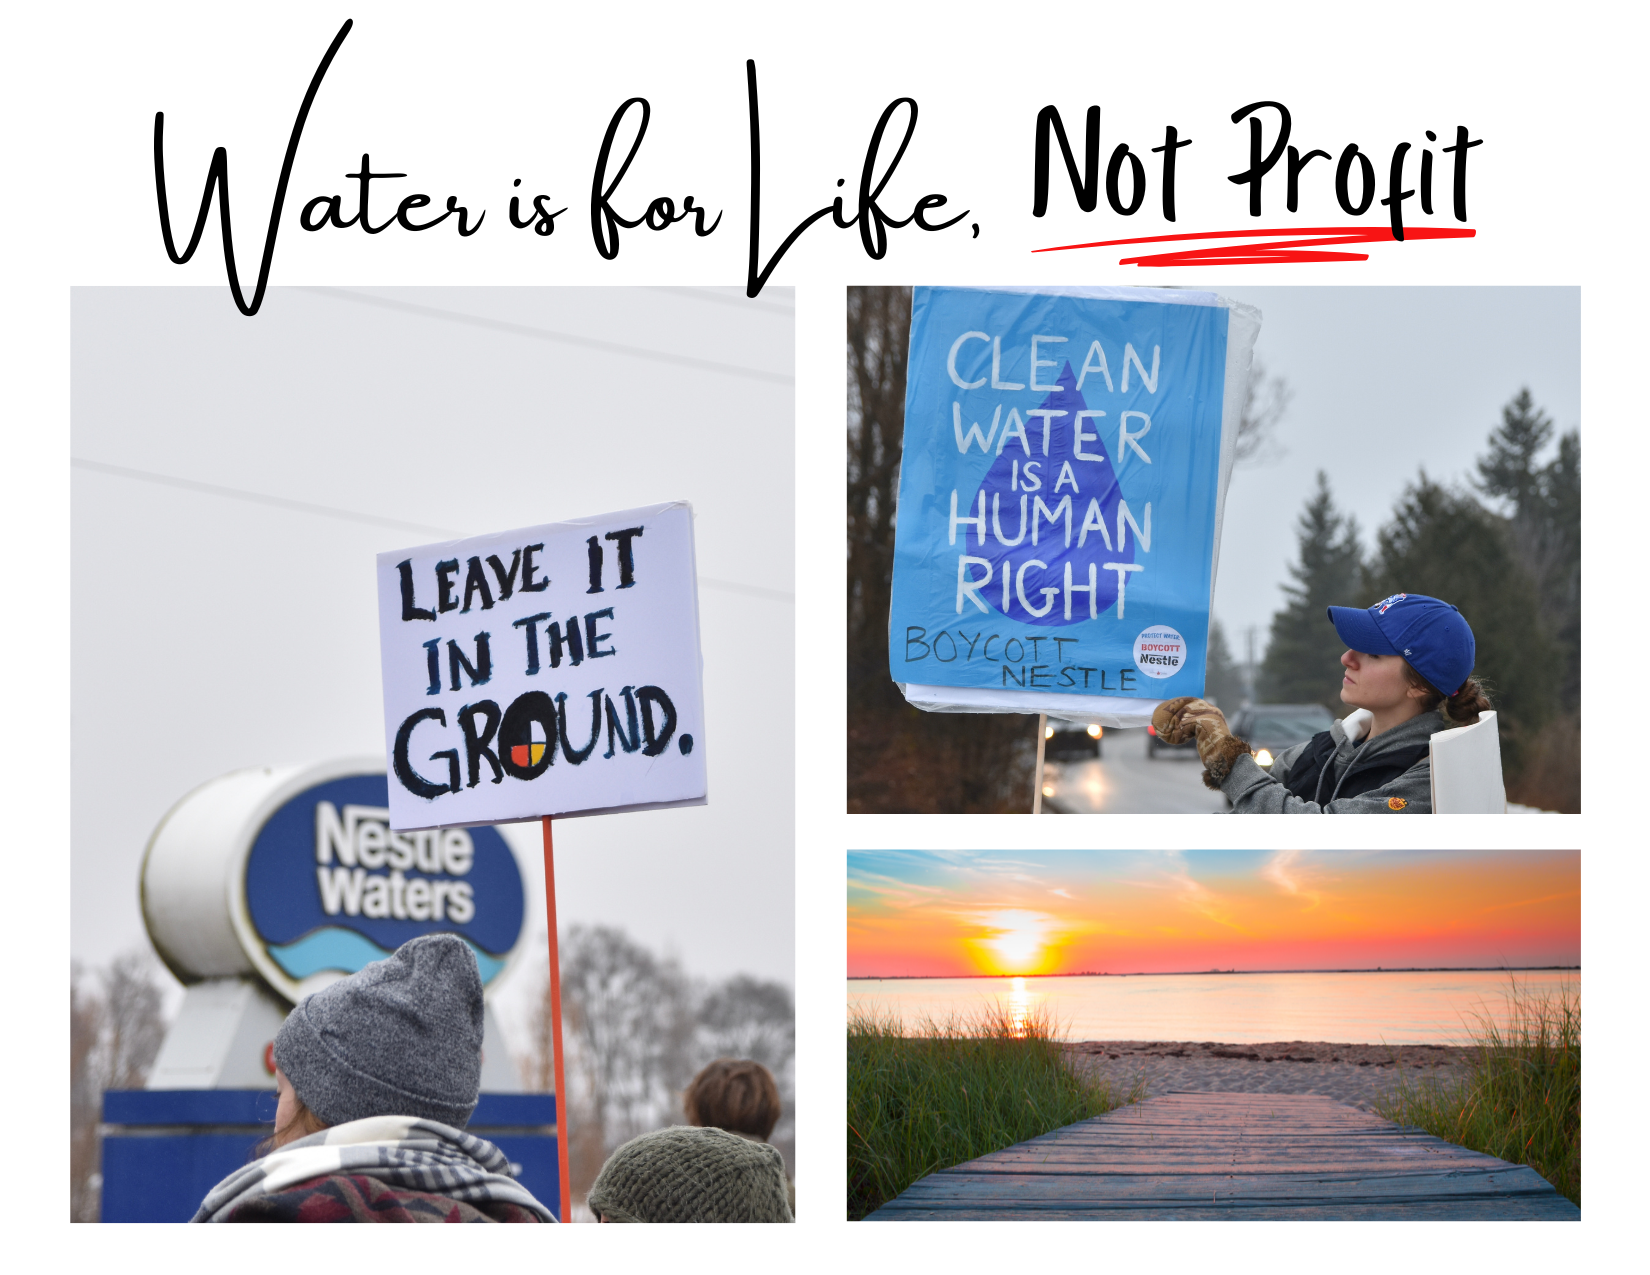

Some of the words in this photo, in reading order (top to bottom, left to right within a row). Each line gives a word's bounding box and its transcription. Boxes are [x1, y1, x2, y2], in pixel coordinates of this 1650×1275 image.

[947, 331, 1160, 394] CLEAN
[953, 401, 1152, 464] WATER
[1012, 460, 1042, 492] IS
[1054, 460, 1080, 494] A
[949, 489, 1151, 553] HUMAN
[395, 542, 551, 622] LEAVE
[586, 525, 645, 594] IT
[956, 555, 1145, 621] RIGHT
[422, 630, 493, 695] IN
[512, 606, 617, 676] THE
[904, 626, 1079, 663] BOYCOTT
[1140, 653, 1179, 666] Nestle
[1141, 643, 1180, 652] BOYCOTT
[1002, 665, 1138, 691] NESTLE
[393, 685, 694, 802] GROUND.
[316, 864, 476, 923] Waters
